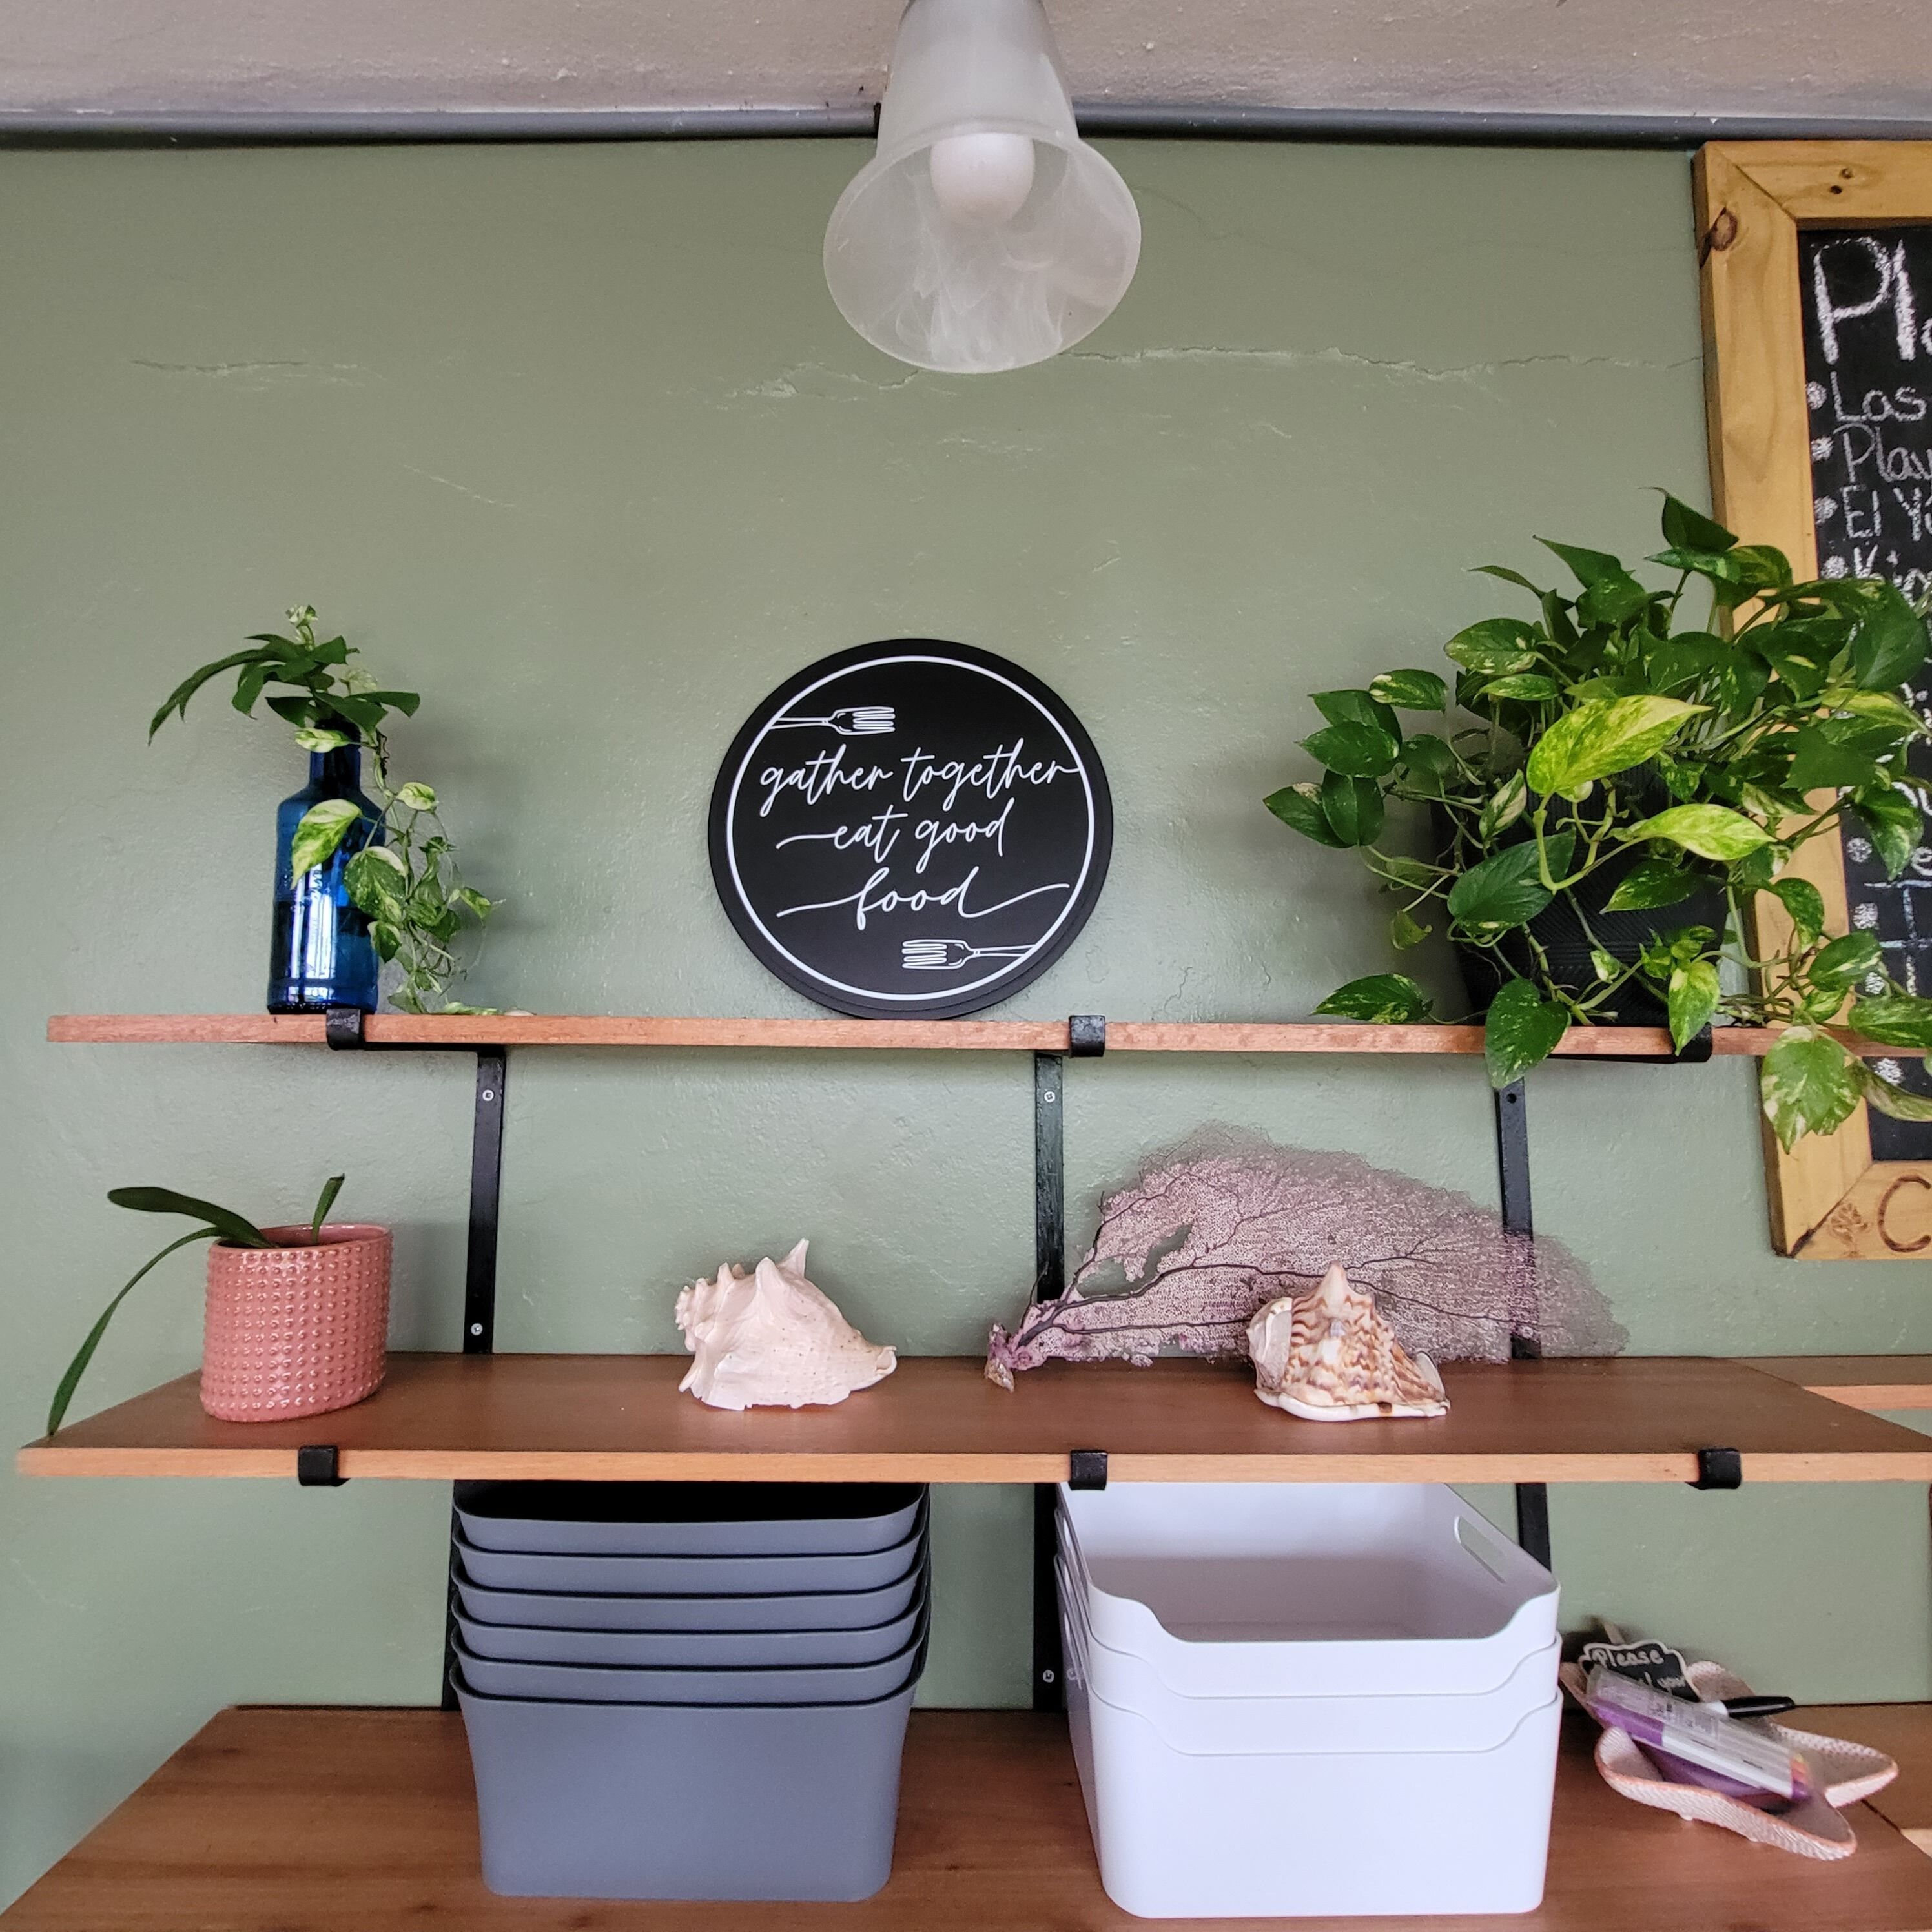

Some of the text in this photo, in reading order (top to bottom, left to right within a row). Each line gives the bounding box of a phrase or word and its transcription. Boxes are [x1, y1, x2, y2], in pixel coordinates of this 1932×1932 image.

[760, 738, 1080, 817] gather together
[915, 797, 1014, 874] good
[777, 867, 1069, 930] food
[1590, 1647, 1665, 1668] Please
